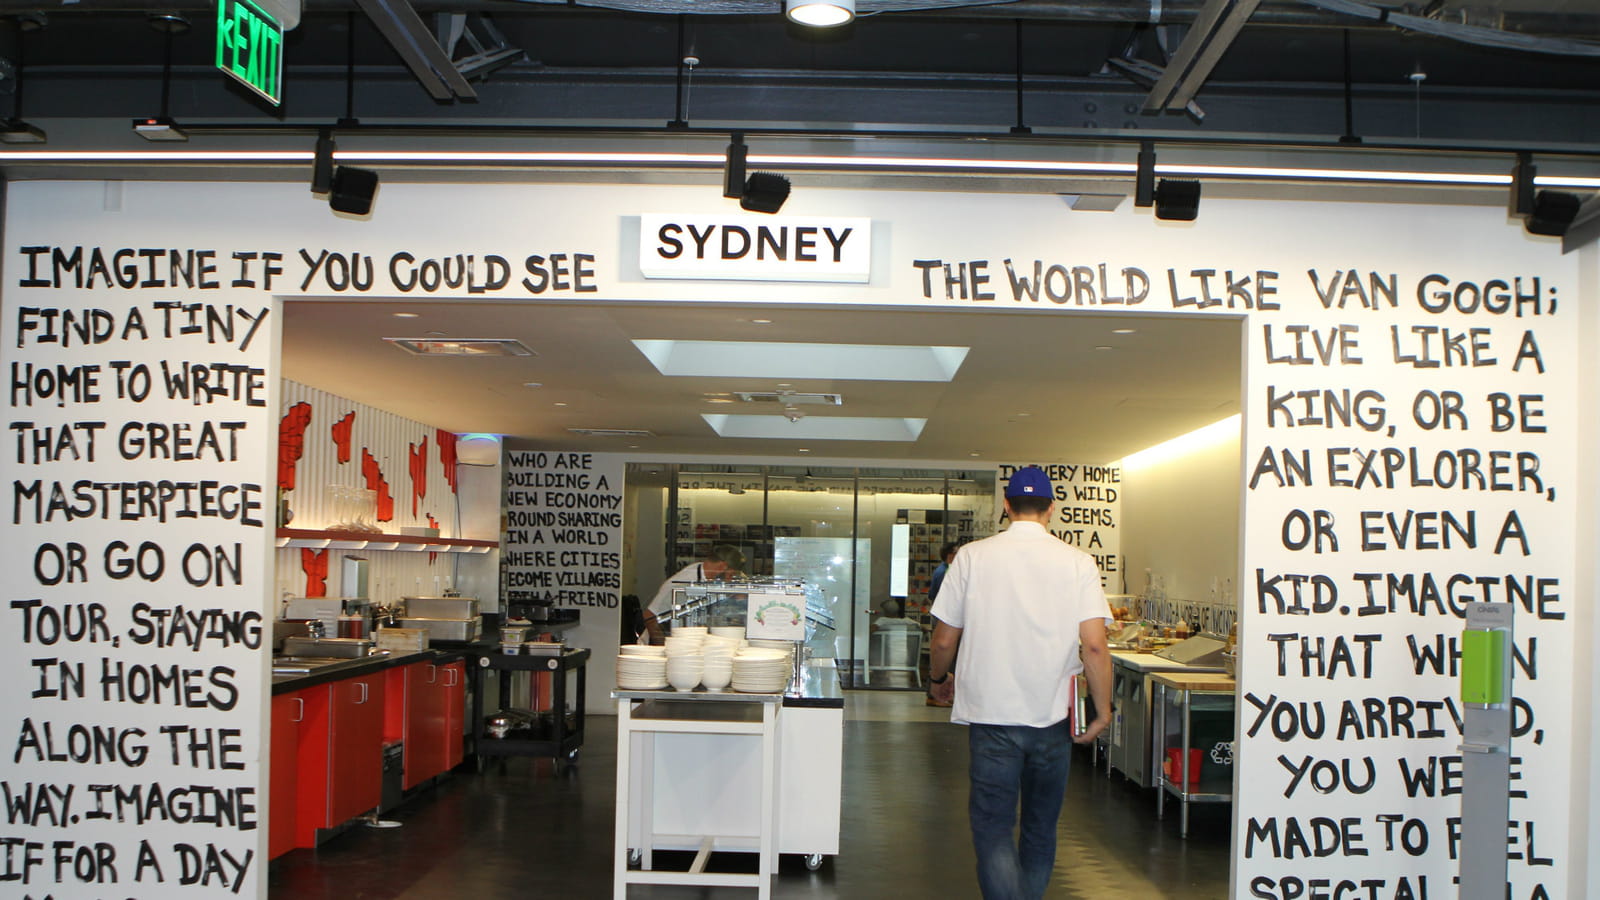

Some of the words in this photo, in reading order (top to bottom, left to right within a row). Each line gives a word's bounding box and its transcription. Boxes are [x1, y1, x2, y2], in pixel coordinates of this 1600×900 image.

[233, 1, 281, 98] EXIT
[657, 223, 854, 262] SYDNEY
[19, 246, 220, 289] IMAGINE
[231, 252, 283, 290] IF
[299, 248, 373, 292] YOU
[389, 251, 511, 294] COULD
[522, 253, 598, 294] SEE
[913, 259, 995, 301] THE
[1004, 259, 1150, 305] WORLD
[1168, 268, 1281, 311] LIKE
[1307, 268, 1399, 310] VAN
[1417, 274, 1558, 318] GOGH;
[17, 306, 115, 348] FIND
[121, 307, 148, 340] A
[153, 301, 270, 352] TINY
[1263, 324, 1363, 366] LIVE
[1391, 325, 1498, 369] LIKE
[1512, 330, 1546, 374] A
[10, 361, 101, 407] HOME
[109, 361, 151, 402] TO
[160, 360, 267, 407] WRITE
[1267, 385, 1396, 438] KING,
[1413, 389, 1468, 431] OR
[1487, 392, 1547, 433] BE
[9, 421, 106, 464] THAT
[118, 421, 247, 462] GREAT
[508, 452, 548, 468] WHO
[555, 453, 592, 469] ARE
[596, 475, 609, 491] A
[1074, 486, 1117, 503] WILD
[1083, 465, 1120, 483] HOME
[1249, 446, 1312, 490] AN
[1327, 446, 1556, 502] EXPLORER,
[13, 480, 263, 527] MASTERPIECE
[546, 492, 622, 510] ECONOMY
[558, 512, 621, 527] SHARING
[1060, 507, 1115, 528] SEEMS.
[507, 530, 528, 544] IN
[533, 530, 544, 544] A
[552, 529, 608, 545] WORLD
[1088, 531, 1103, 548] A
[1282, 509, 1339, 554] OR
[1360, 509, 1477, 552] EVEN
[1494, 509, 1531, 556] A
[34, 543, 87, 586] OR
[104, 541, 165, 582] GO
[182, 543, 242, 587] ON
[555, 572, 620, 588] VILLAGES
[560, 551, 620, 569] CITIES
[559, 590, 619, 608] FRIEND
[10, 599, 120, 648] TOUR,
[128, 603, 263, 651] STAYING
[1267, 633, 1382, 680] THAT
[31, 658, 85, 700] IN
[100, 657, 239, 711] HOMES
[1244, 692, 1326, 742] YOU
[14, 717, 149, 767] ALONG
[160, 725, 246, 770] THE
[1277, 755, 1376, 799] YOU
[1, 781, 79, 828] WAY.
[86, 783, 257, 831] IMAGINE
[1244, 816, 1369, 860] MADE
[1376, 814, 1429, 856] TO
[0, 838, 44, 884] IF
[53, 841, 118, 883] FOR
[135, 840, 164, 883] A
[173, 843, 254, 893] DAY
